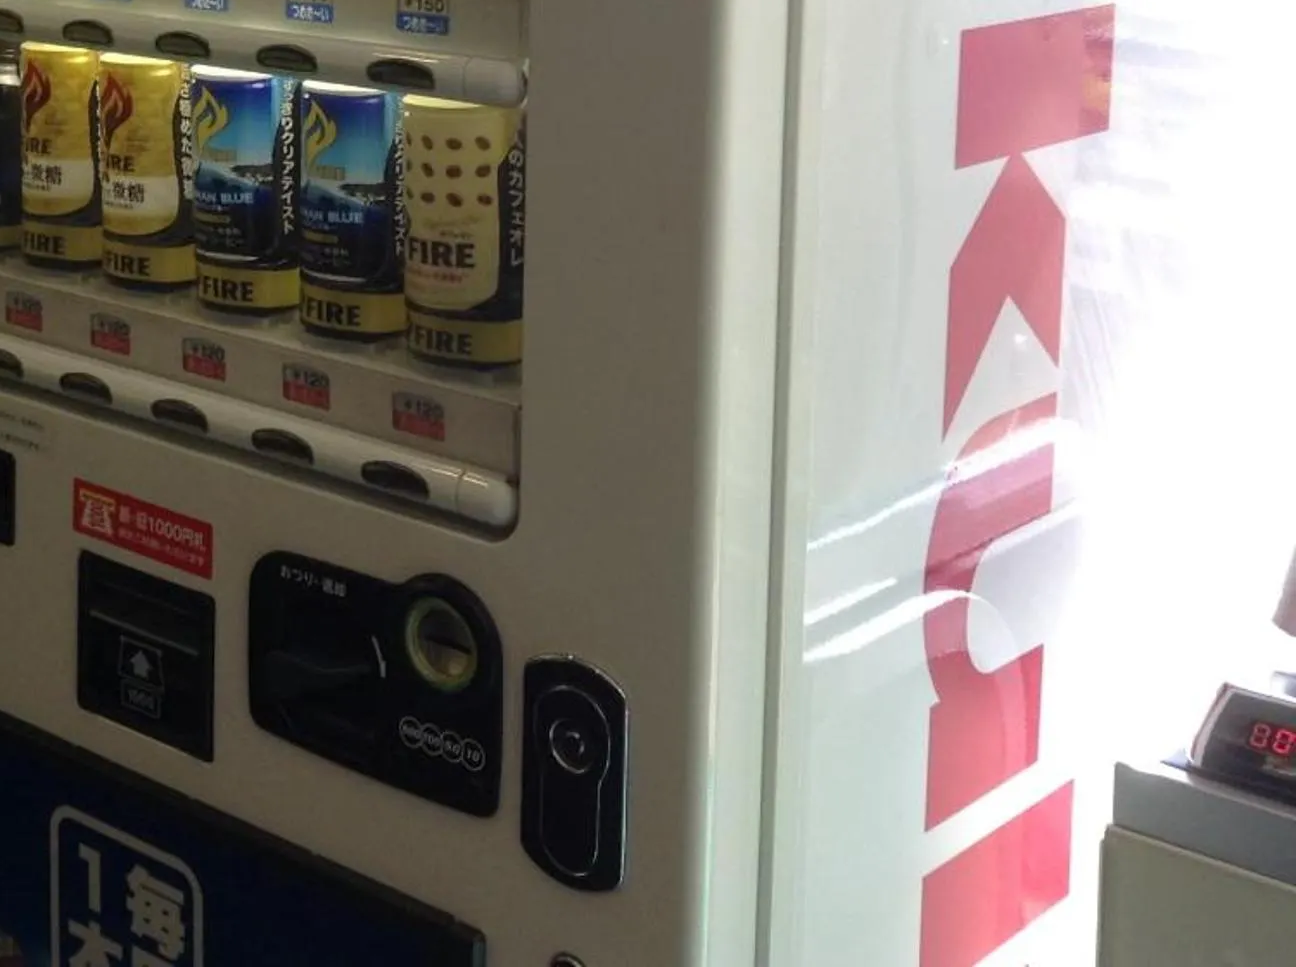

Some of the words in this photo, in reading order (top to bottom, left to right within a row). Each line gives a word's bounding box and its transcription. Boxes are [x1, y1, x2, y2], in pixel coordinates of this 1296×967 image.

[25, 137, 52, 154] IRE
[106, 154, 136, 173] IRE
[220, 191, 253, 205] BLUE
[327, 211, 364, 225] BLUE
[105, 249, 151, 277] FIRE
[408, 236, 477, 269] FIRE
[201, 275, 255, 302] FIRE
[306, 297, 362, 326] FIRE
[413, 325, 472, 356] FIRE
